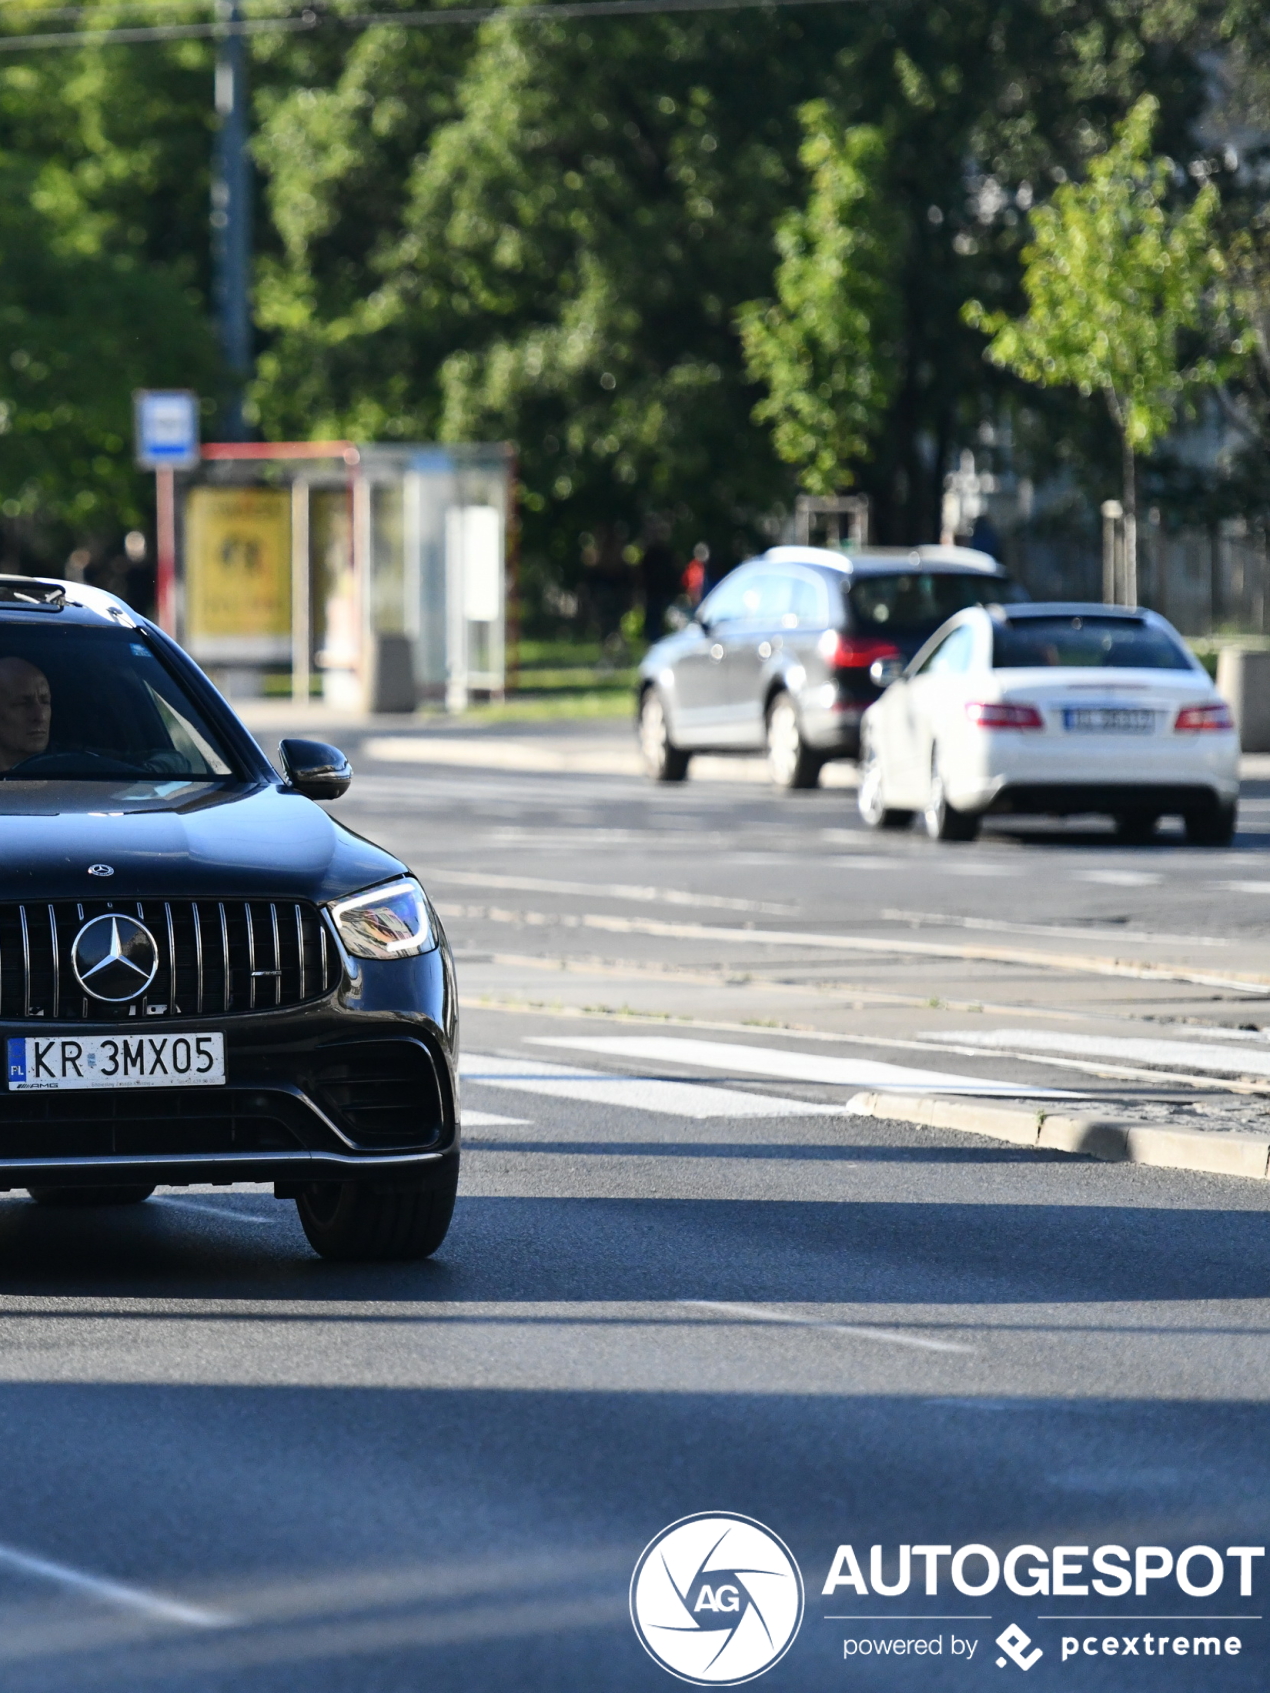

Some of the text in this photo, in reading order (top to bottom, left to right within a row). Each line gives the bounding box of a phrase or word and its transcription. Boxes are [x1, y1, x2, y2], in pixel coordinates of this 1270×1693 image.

[34, 1036, 214, 1078] KR 3MX05
[10, 1065, 24, 1076] PL
